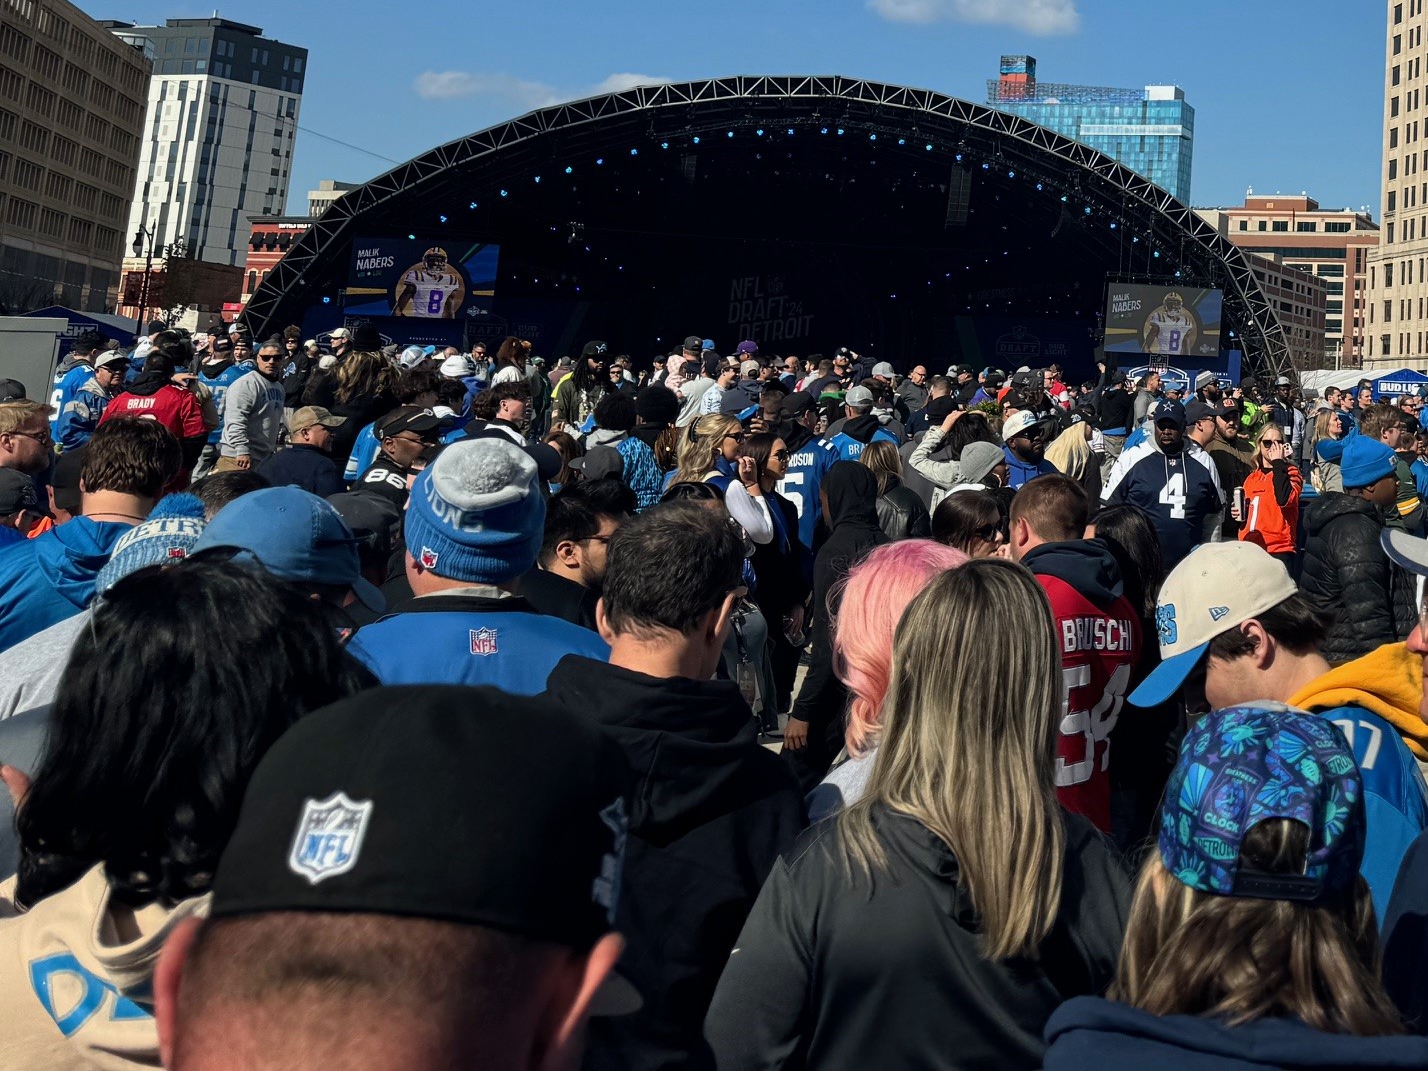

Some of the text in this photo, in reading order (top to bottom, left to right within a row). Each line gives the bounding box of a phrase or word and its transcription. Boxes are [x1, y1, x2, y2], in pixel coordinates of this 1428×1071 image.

[356, 256, 395, 271] NABERS
[358, 248, 380, 258] MALIK
[730, 275, 764, 300] NFL
[1112, 293, 1131, 301] MALIK
[428, 289, 444, 314] 8
[727, 295, 789, 324] DRAFT
[1112, 300, 1142, 313] NABERS
[467, 323, 503, 335] RAFT
[1169, 330, 1181, 351] 8
[1380, 382, 1401, 391] BUD
[127, 398, 155, 409] BRADY
[788, 452, 814, 467] RDSON
[364, 468, 407, 489] 86
[424, 474, 484, 533] LIONS
[1159, 473, 1186, 519] 4
[472, 639, 496, 652] NFL
[1062, 618, 1132, 652] BRUSCHI
[1204, 812, 1240, 833] CLOCK
[298, 834, 352, 866] NFL
